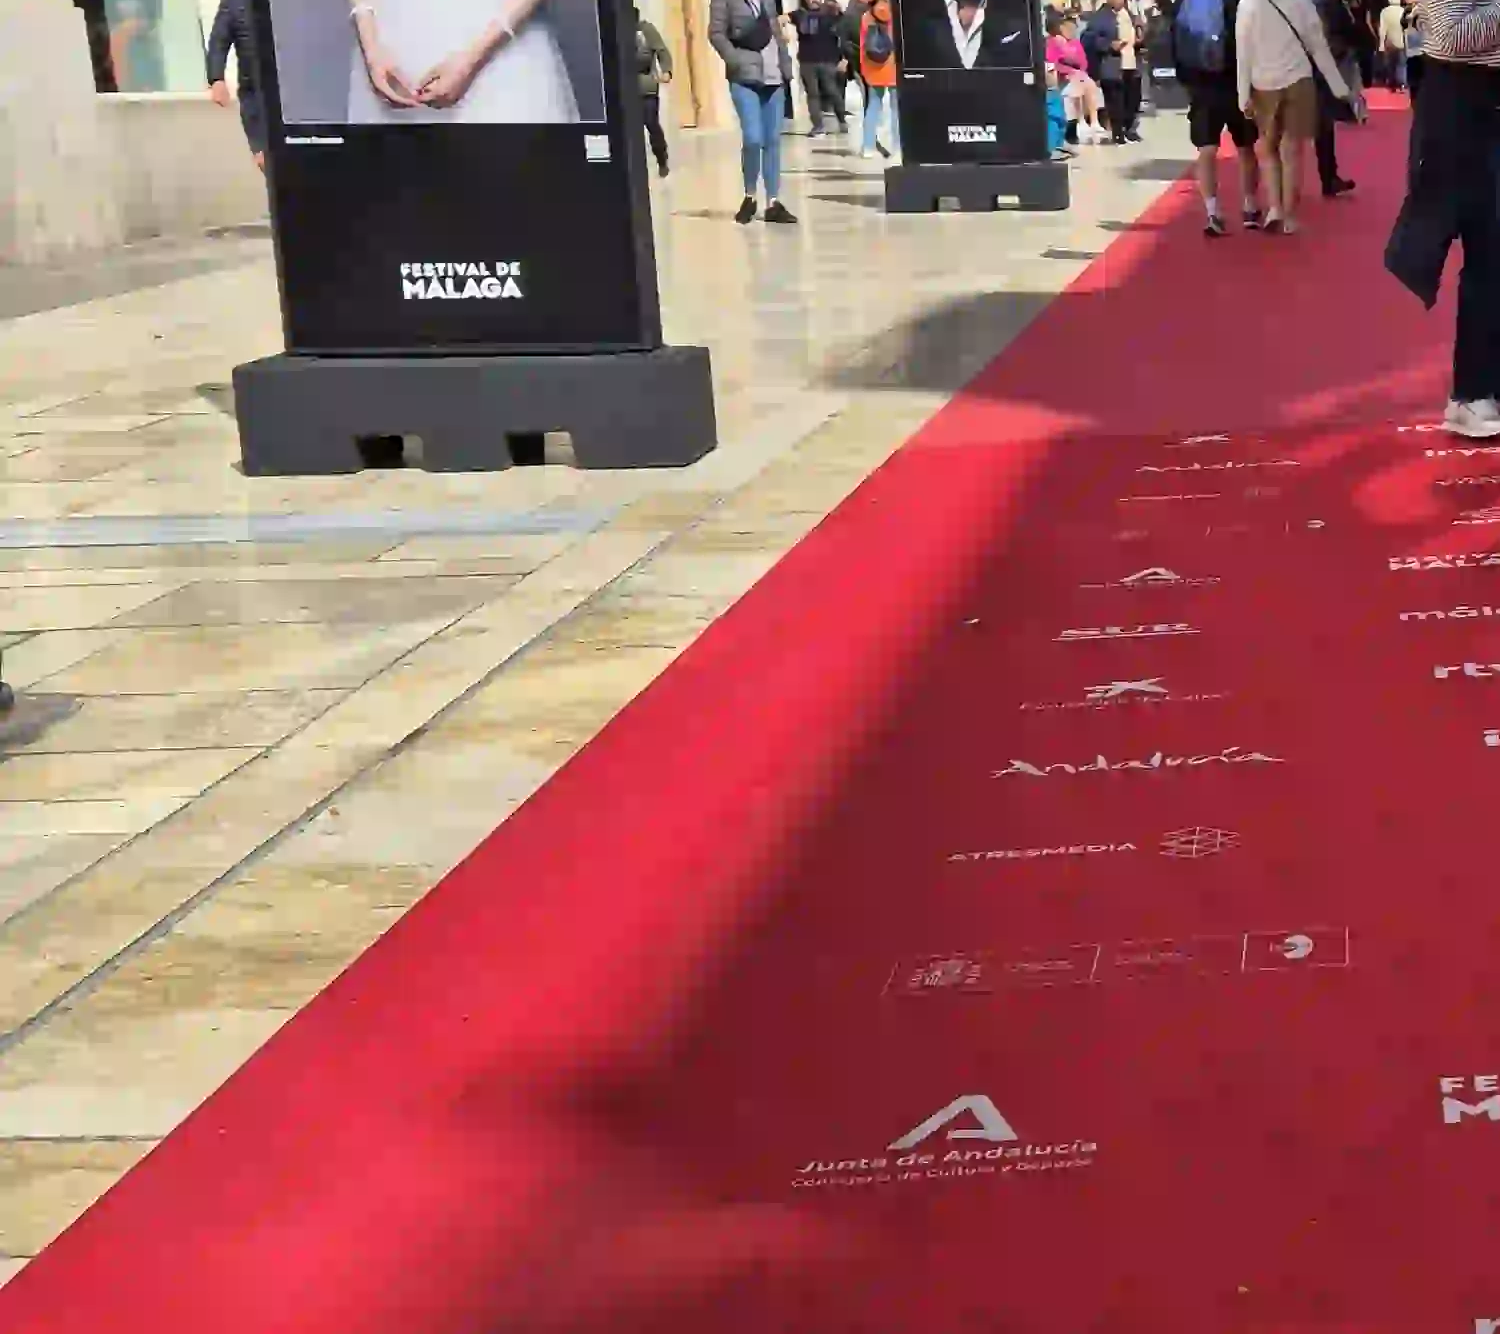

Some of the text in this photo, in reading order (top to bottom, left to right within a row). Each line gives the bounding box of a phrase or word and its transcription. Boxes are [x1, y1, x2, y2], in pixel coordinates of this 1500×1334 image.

[400, 261, 521, 278] FESTIVAL DE
[989, 746, 1286, 779] Andalucía
[945, 841, 1138, 862] ATRESMEDIA
[796, 1138, 1098, 1173] Junta de Andalucía
